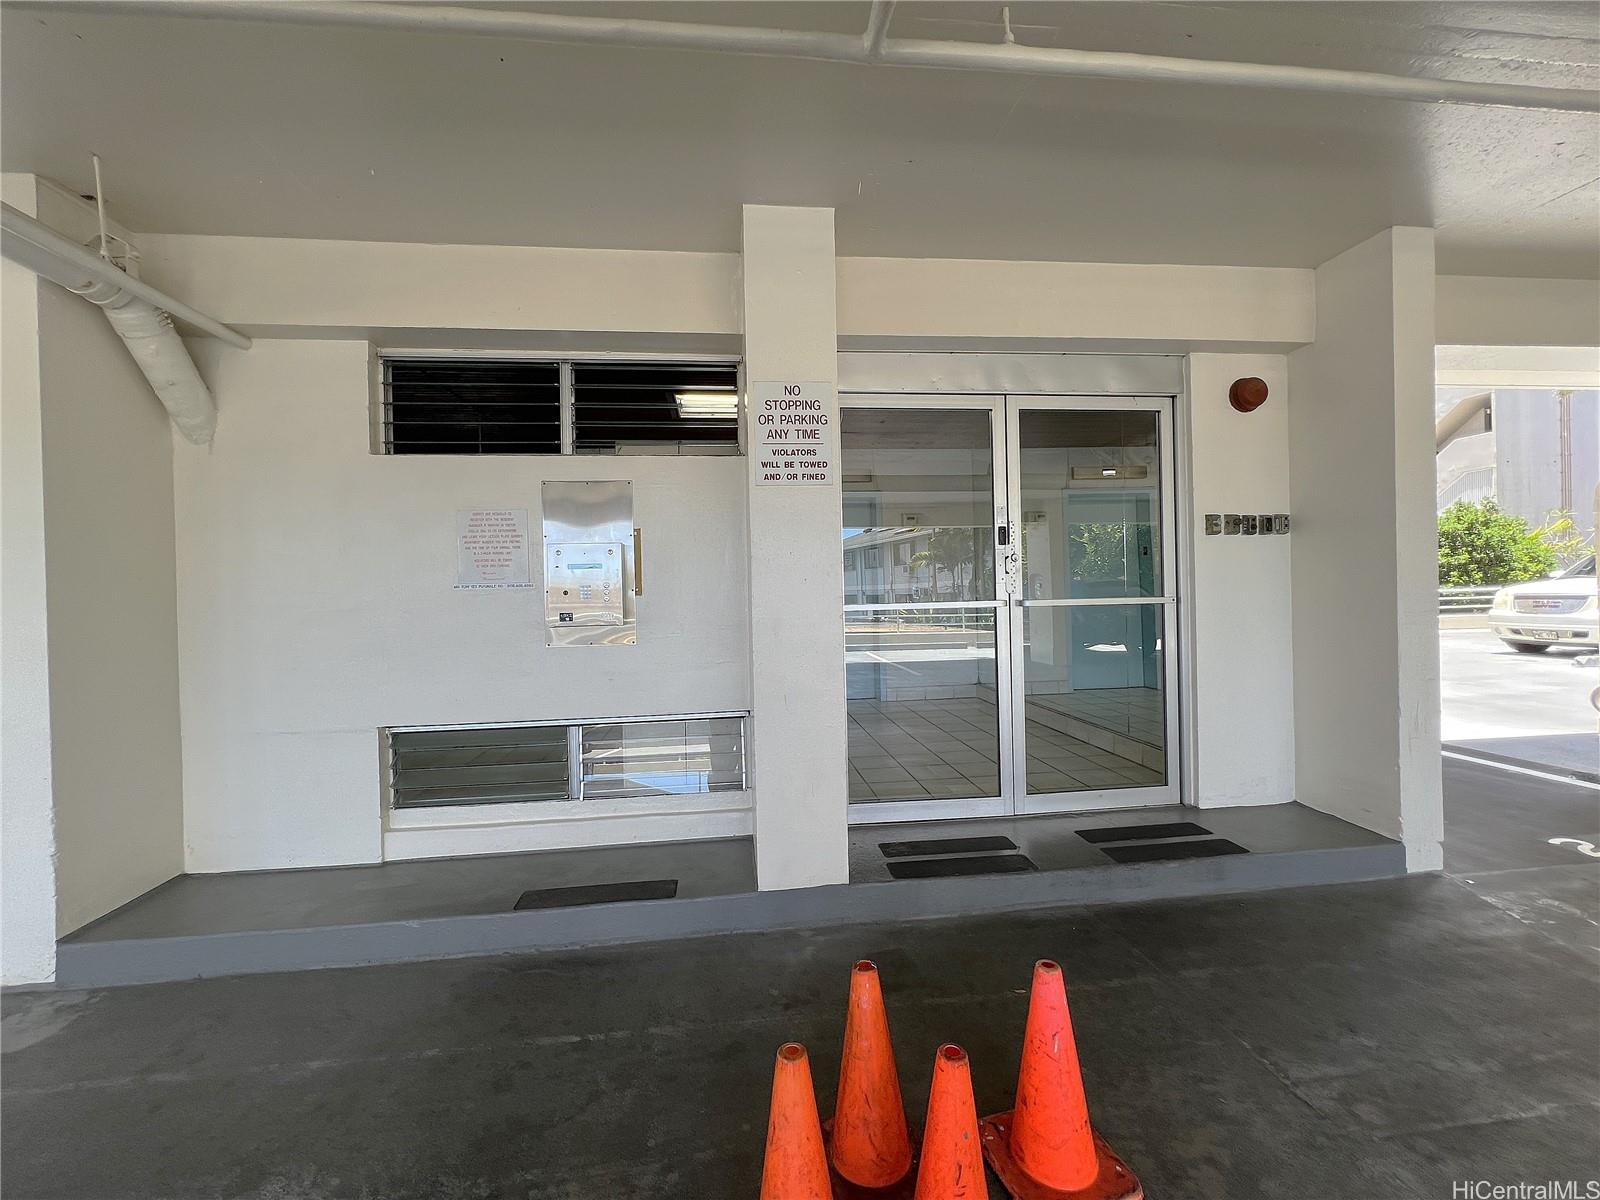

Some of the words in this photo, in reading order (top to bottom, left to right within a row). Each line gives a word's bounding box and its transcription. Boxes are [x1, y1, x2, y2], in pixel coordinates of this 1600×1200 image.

[784, 385, 801, 396] NO
[764, 400, 821, 411] STOPPING
[758, 414, 775, 425] OR
[780, 414, 828, 425] PARKING
[766, 429, 790, 440] ANY
[795, 429, 820, 440] TIME
[763, 473, 798, 481] AND/OR
